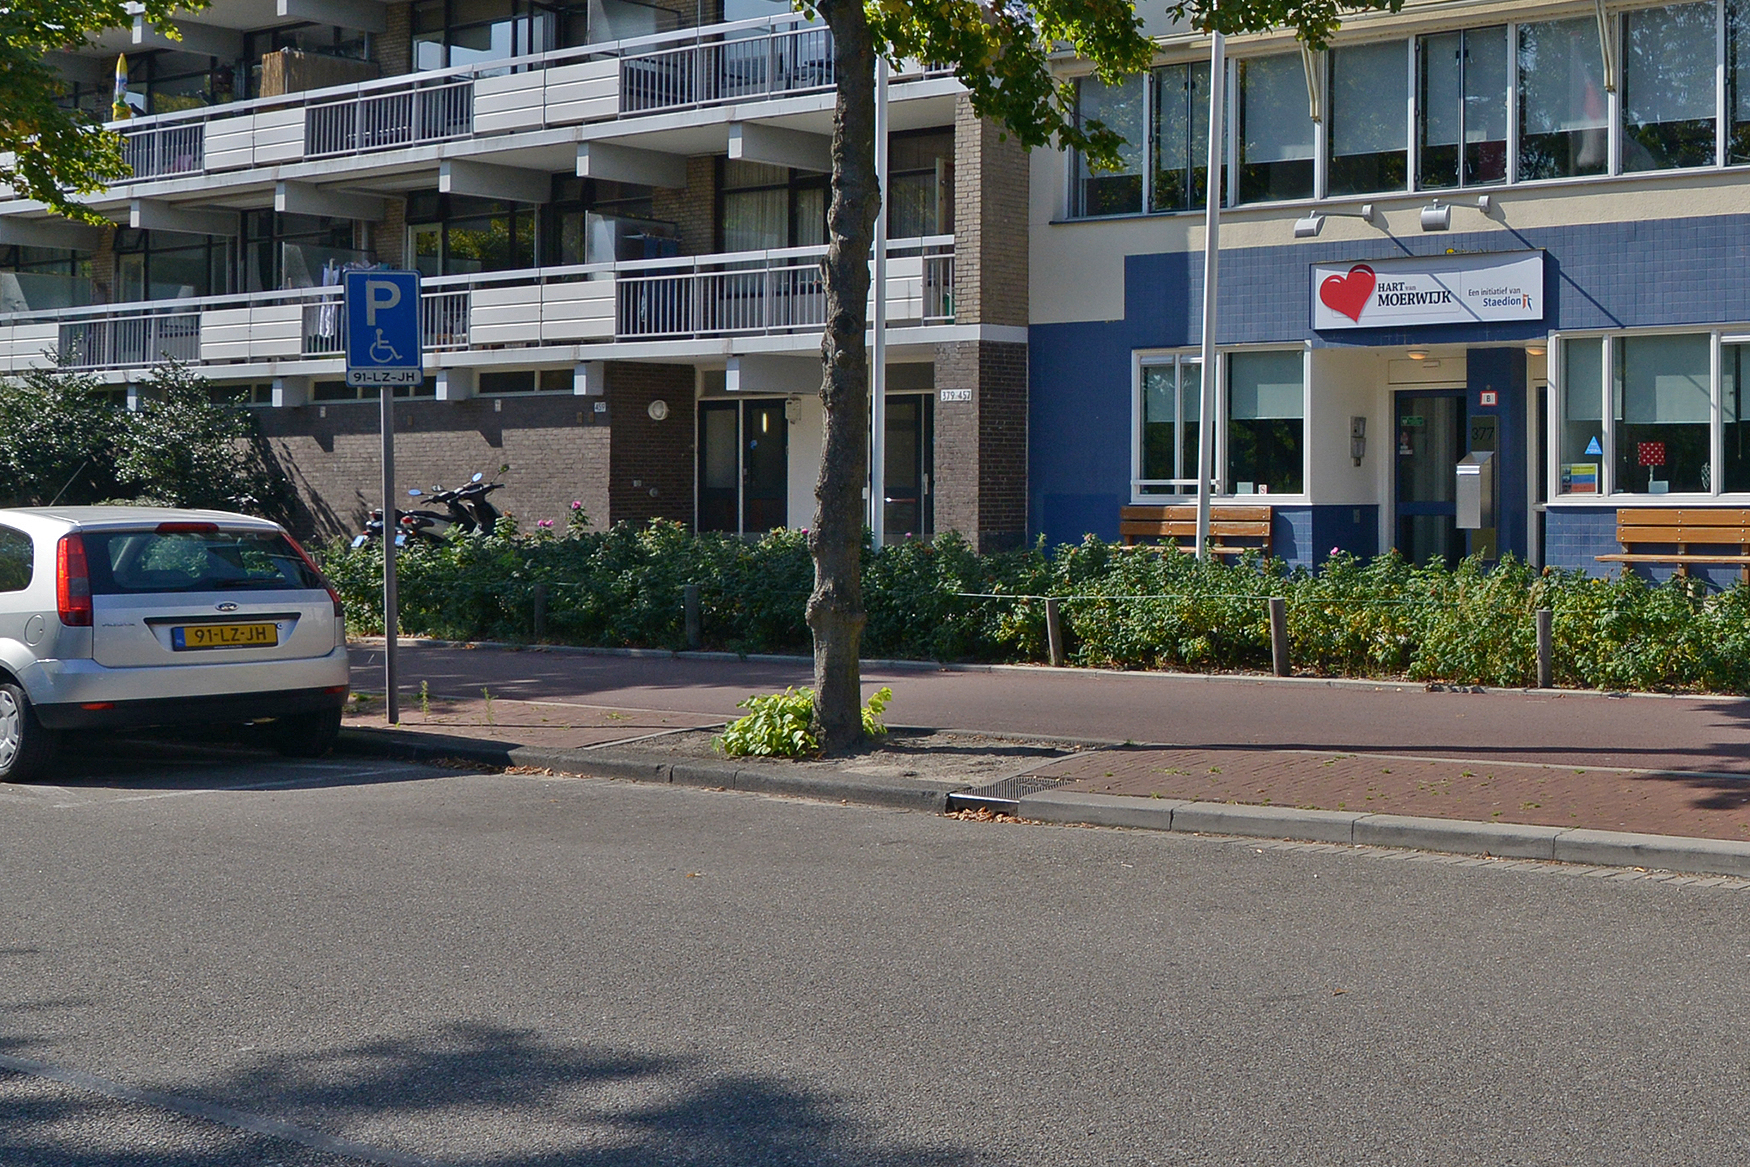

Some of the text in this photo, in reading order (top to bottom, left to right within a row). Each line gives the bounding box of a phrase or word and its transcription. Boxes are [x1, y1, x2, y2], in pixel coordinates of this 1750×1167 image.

[1378, 282, 1405, 292] HART
[1468, 288, 1480, 296] Een
[1481, 287, 1508, 295] initiatief
[365, 280, 401, 326] P
[1378, 290, 1452, 307] MOERWIJK
[1483, 296, 1521, 307] Staedion
[353, 372, 415, 383] 91-LZ-JH
[1472, 427, 1495, 441] 377
[195, 628, 267, 643] 91-LZ-JH
